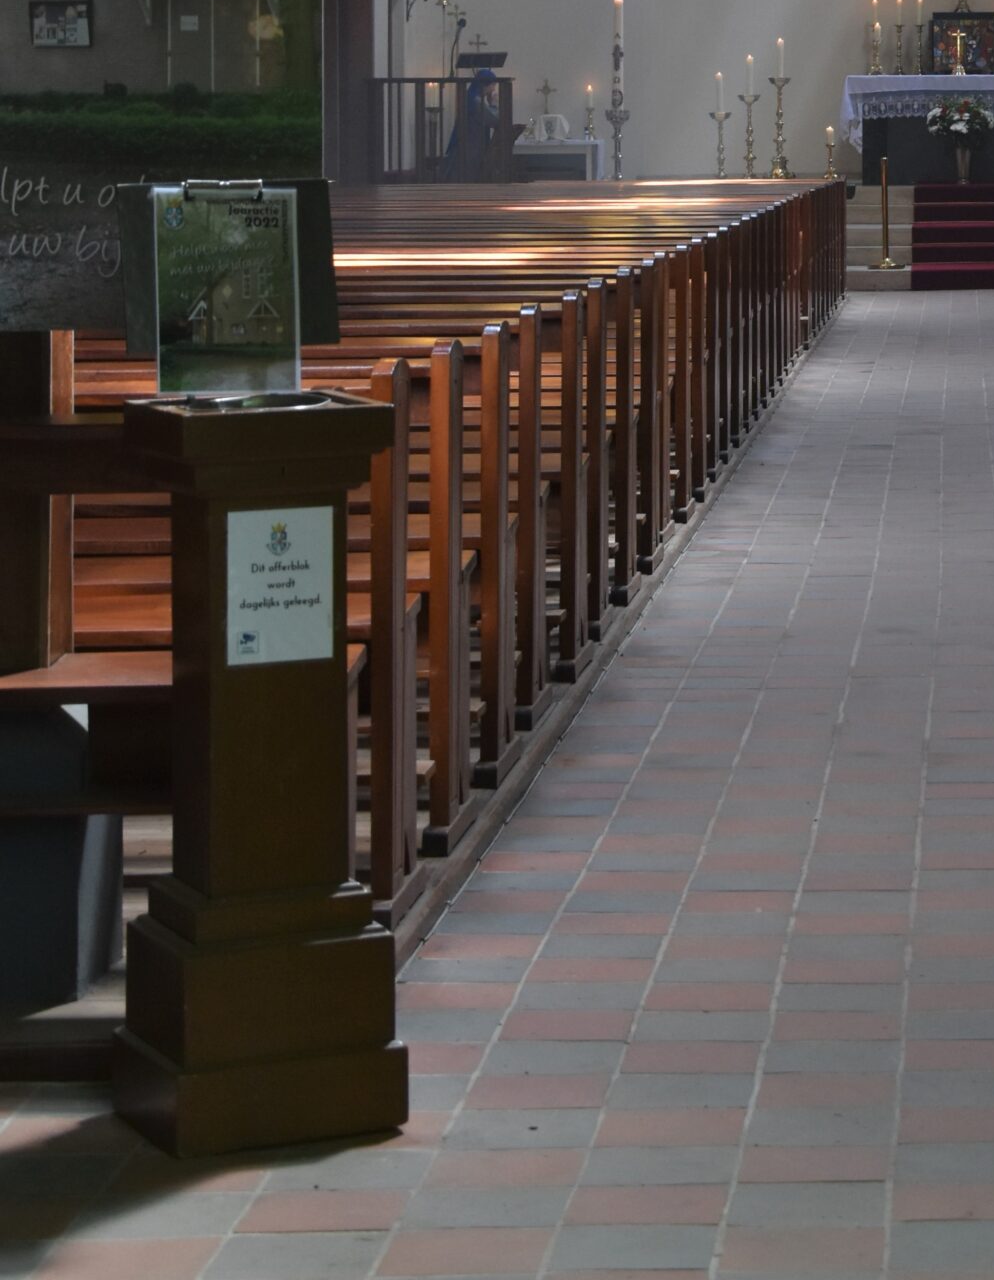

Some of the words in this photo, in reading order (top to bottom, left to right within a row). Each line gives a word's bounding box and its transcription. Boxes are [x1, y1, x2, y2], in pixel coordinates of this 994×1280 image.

[63, 183, 86, 206] u
[228, 204, 280, 216] Jaaractie
[245, 217, 279, 228] 2022
[8, 232, 62, 258] uw
[251, 563, 265, 574] Dit
[268, 560, 310, 573] offerblok
[267, 578, 296, 589] wordt
[239, 597, 280, 611] dagelijks
